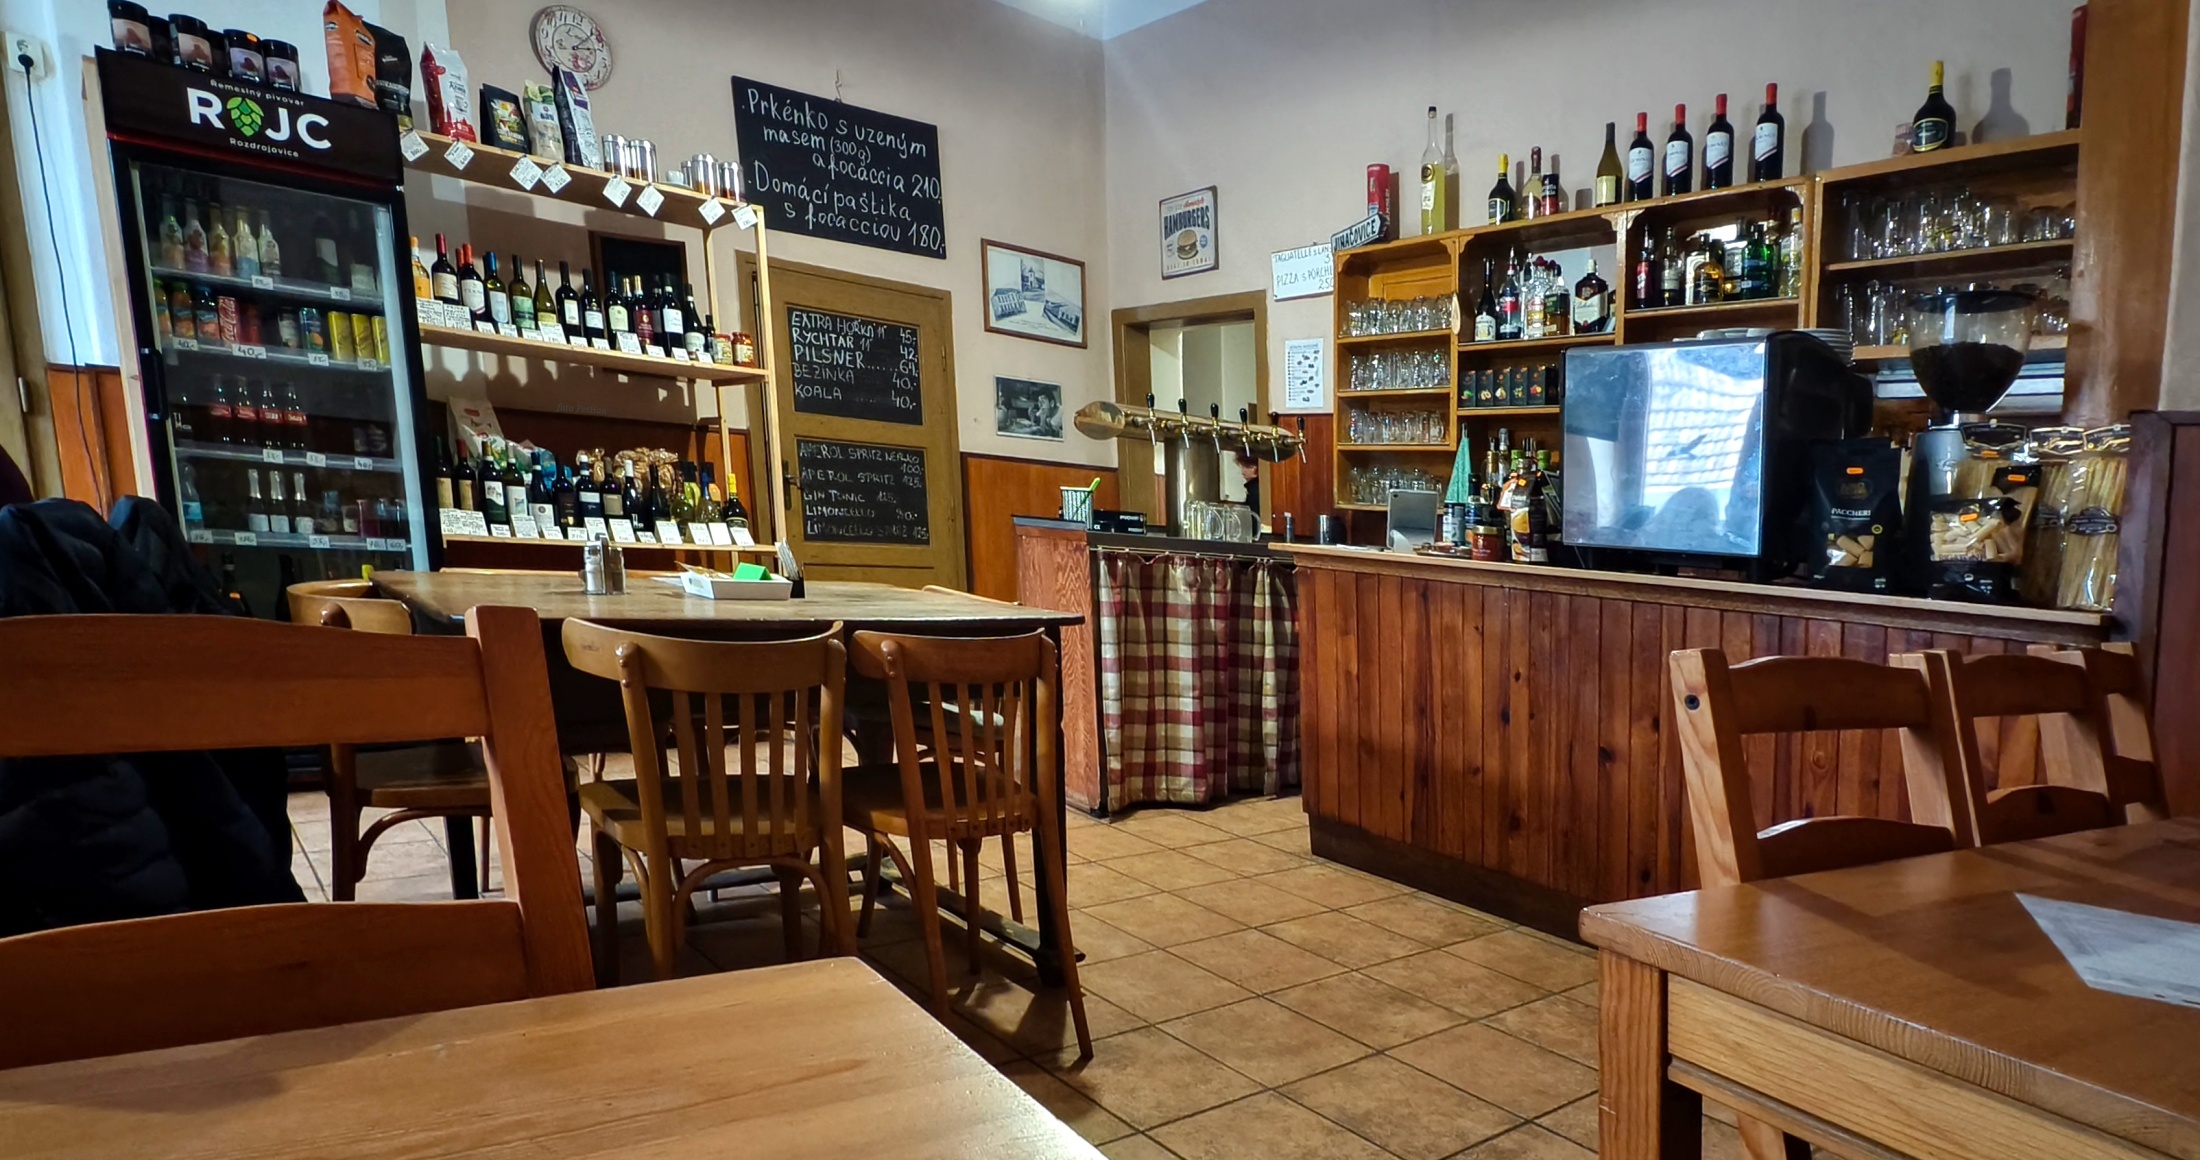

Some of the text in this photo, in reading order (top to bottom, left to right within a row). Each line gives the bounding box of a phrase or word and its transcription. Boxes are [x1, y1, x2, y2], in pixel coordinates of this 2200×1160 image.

[747, 88, 927, 159] Prkénko s uzeným
[229, 137, 299, 158] Rozdrojovice
[763, 126, 826, 151] masem
[754, 160, 912, 222] Domácí paštika
[784, 201, 796, 218] s
[805, 203, 901, 242] focacciou
[1163, 205, 1210, 241] HAMBURGERS
[792, 311, 832, 331] EXTRA
[793, 344, 866, 370] PILSNER
[794, 382, 842, 401] KOALA
